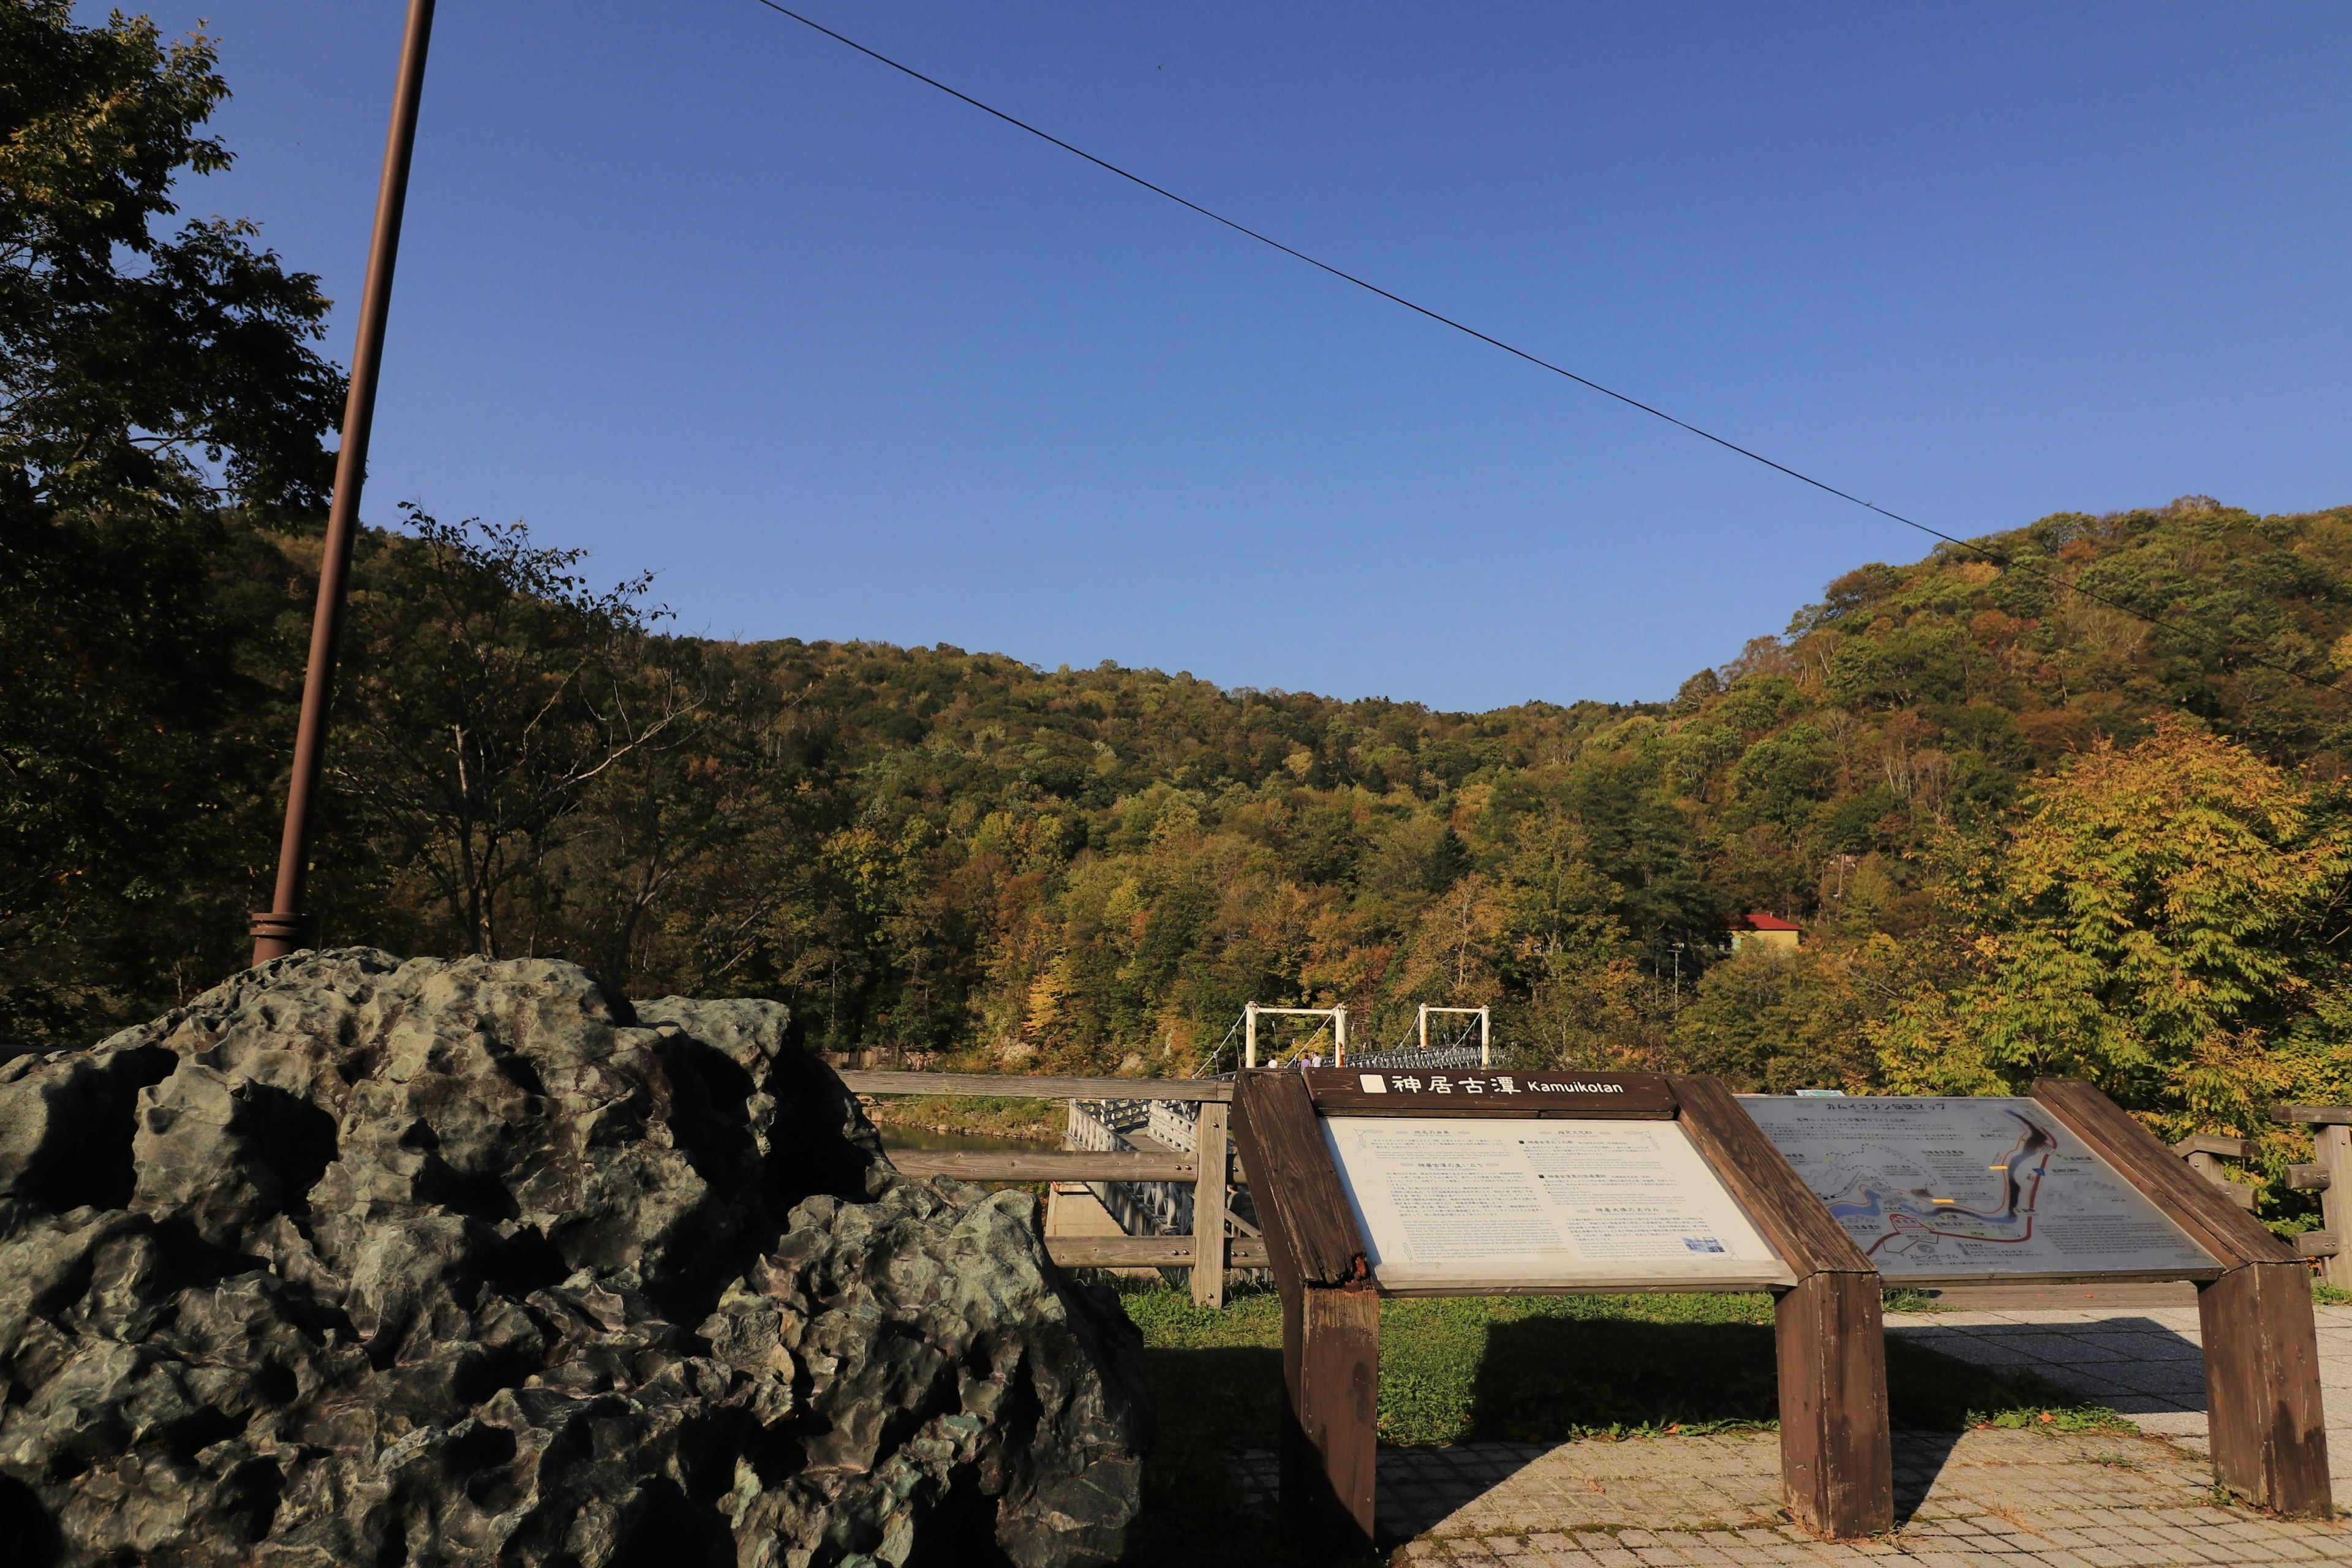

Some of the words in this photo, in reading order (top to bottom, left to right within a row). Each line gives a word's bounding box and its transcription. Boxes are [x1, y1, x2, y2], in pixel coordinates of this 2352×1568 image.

[1392, 1074, 1521, 1095] 神居古潭
[1527, 1080, 1624, 1093] Kamuikotan
